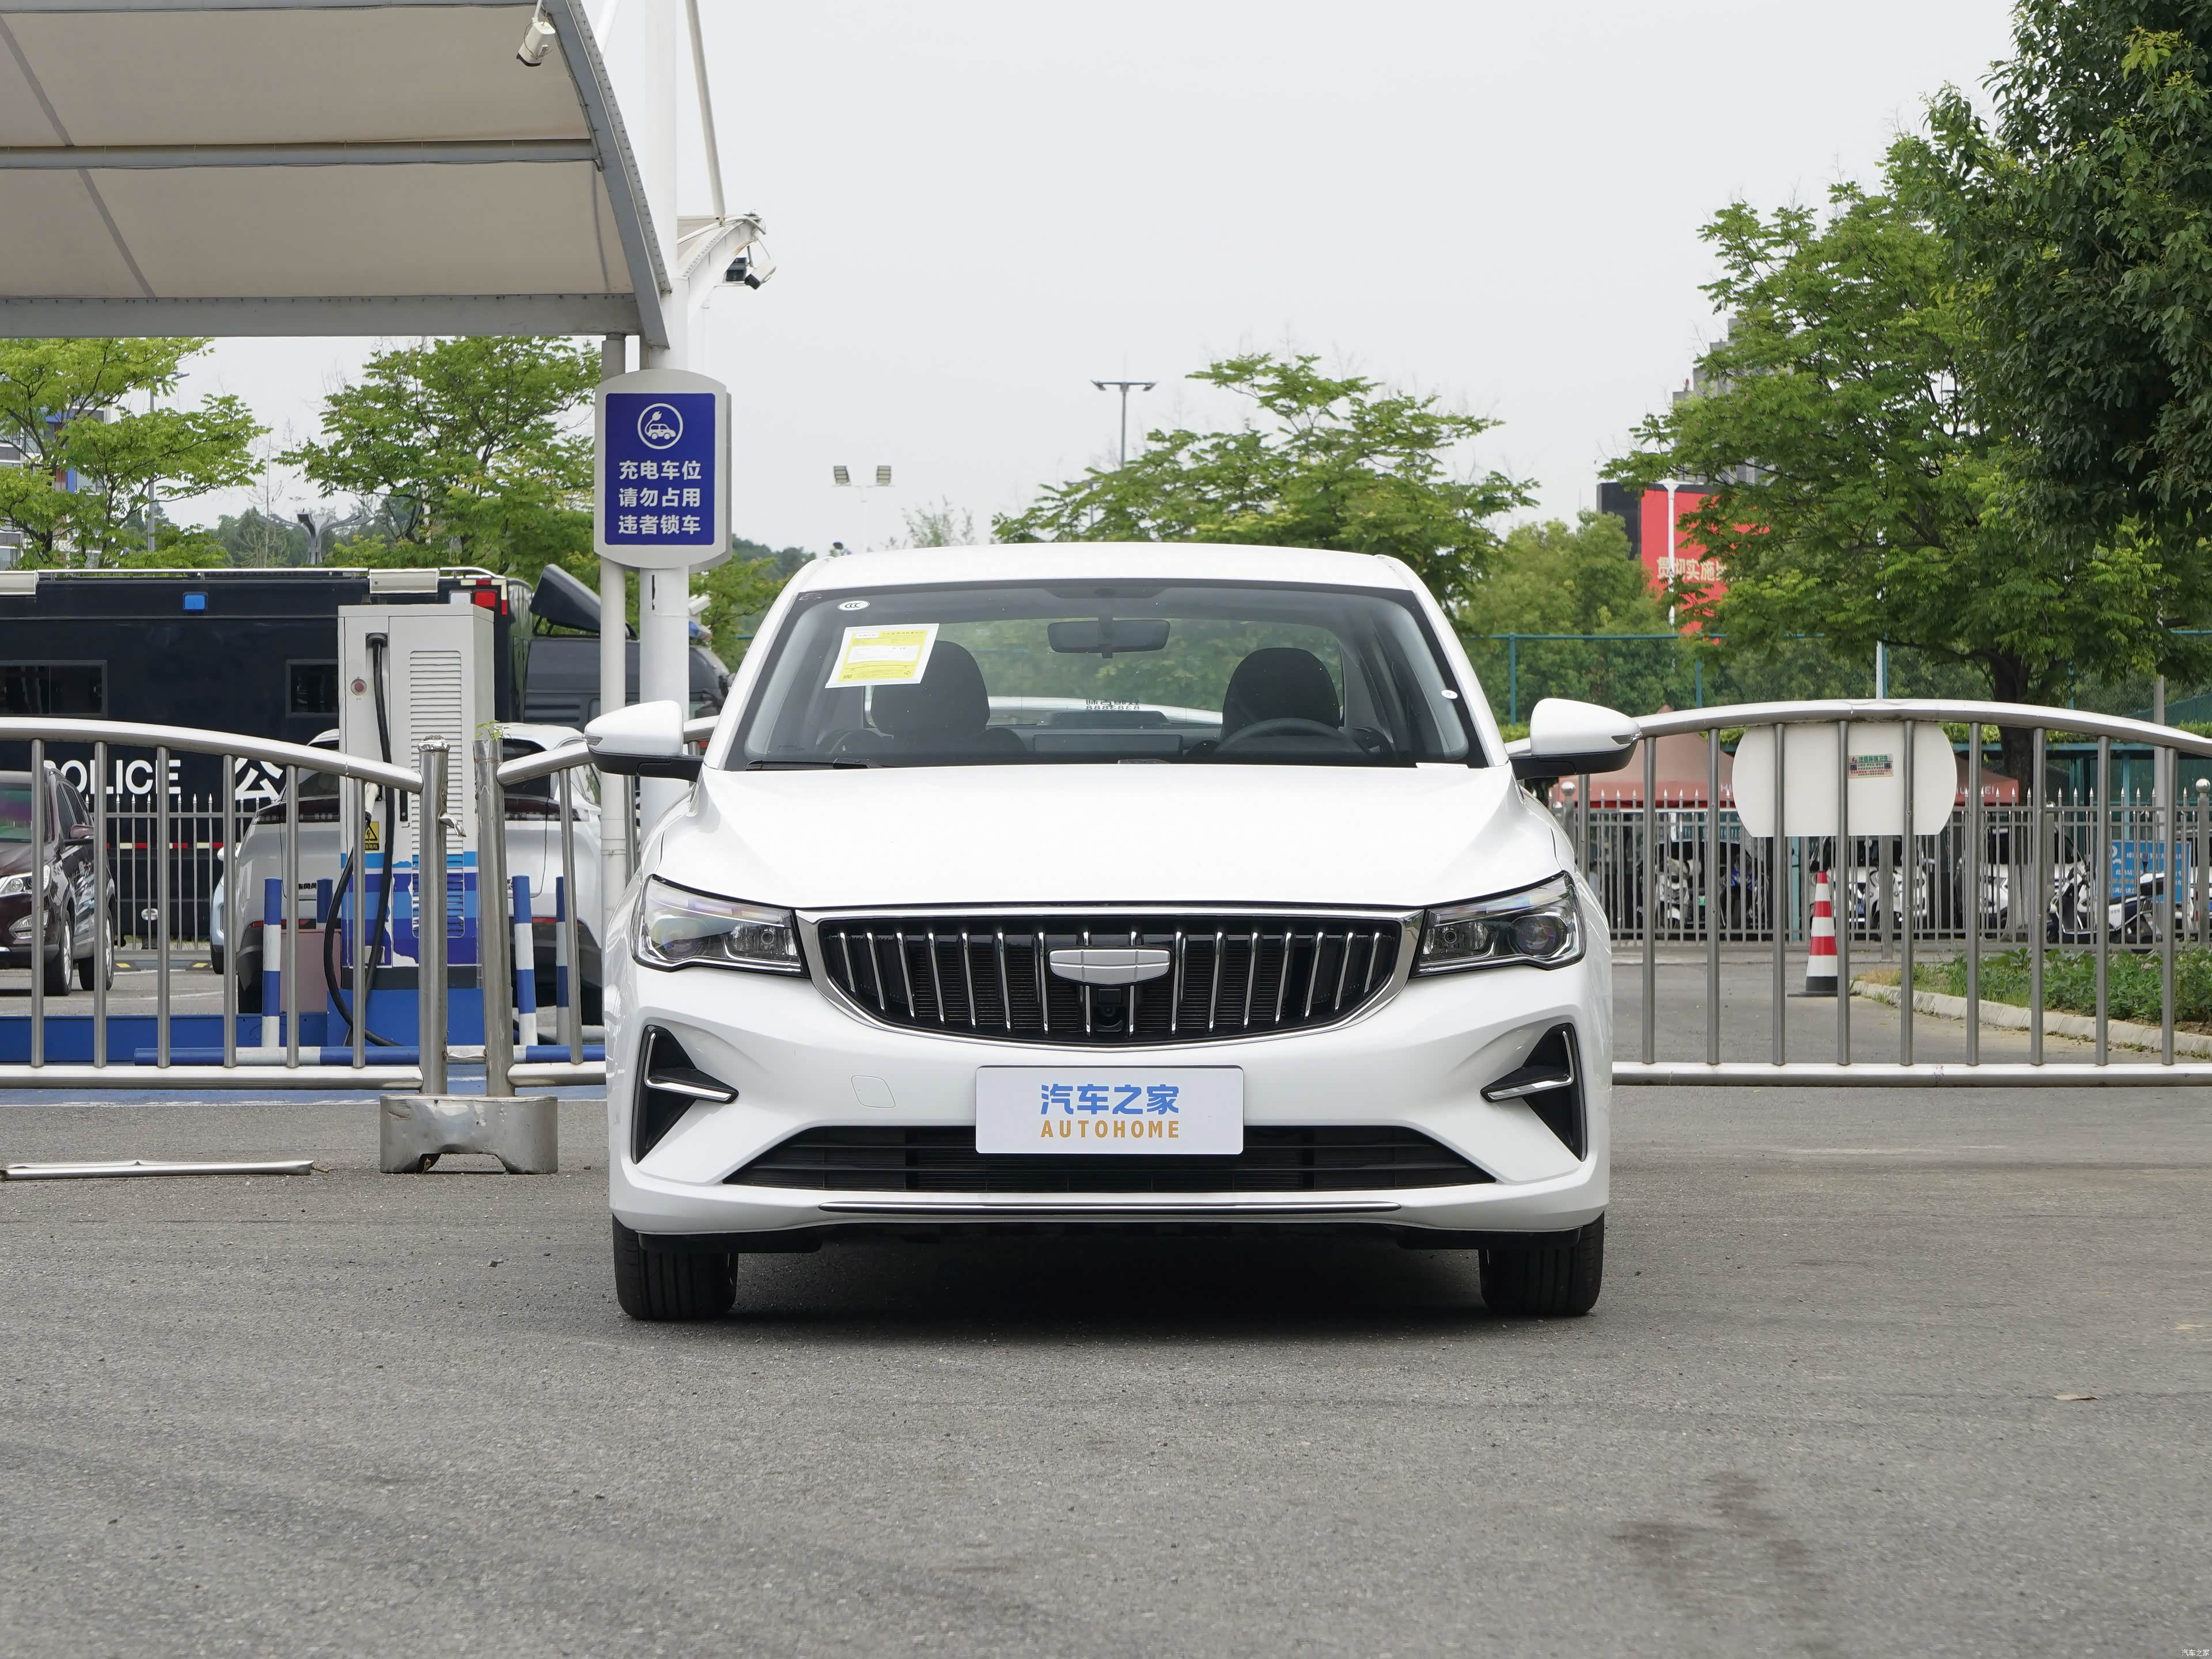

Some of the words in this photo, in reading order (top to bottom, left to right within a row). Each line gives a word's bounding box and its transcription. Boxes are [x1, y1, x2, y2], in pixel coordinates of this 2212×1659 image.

[619, 460, 701, 480] 充电车位
[619, 487, 700, 507] 请勿占用
[618, 514, 700, 535] 违者锁车
[1040, 1084, 1179, 1115] 汽车之家
[1041, 1120, 1179, 1138] AUTOHOME
